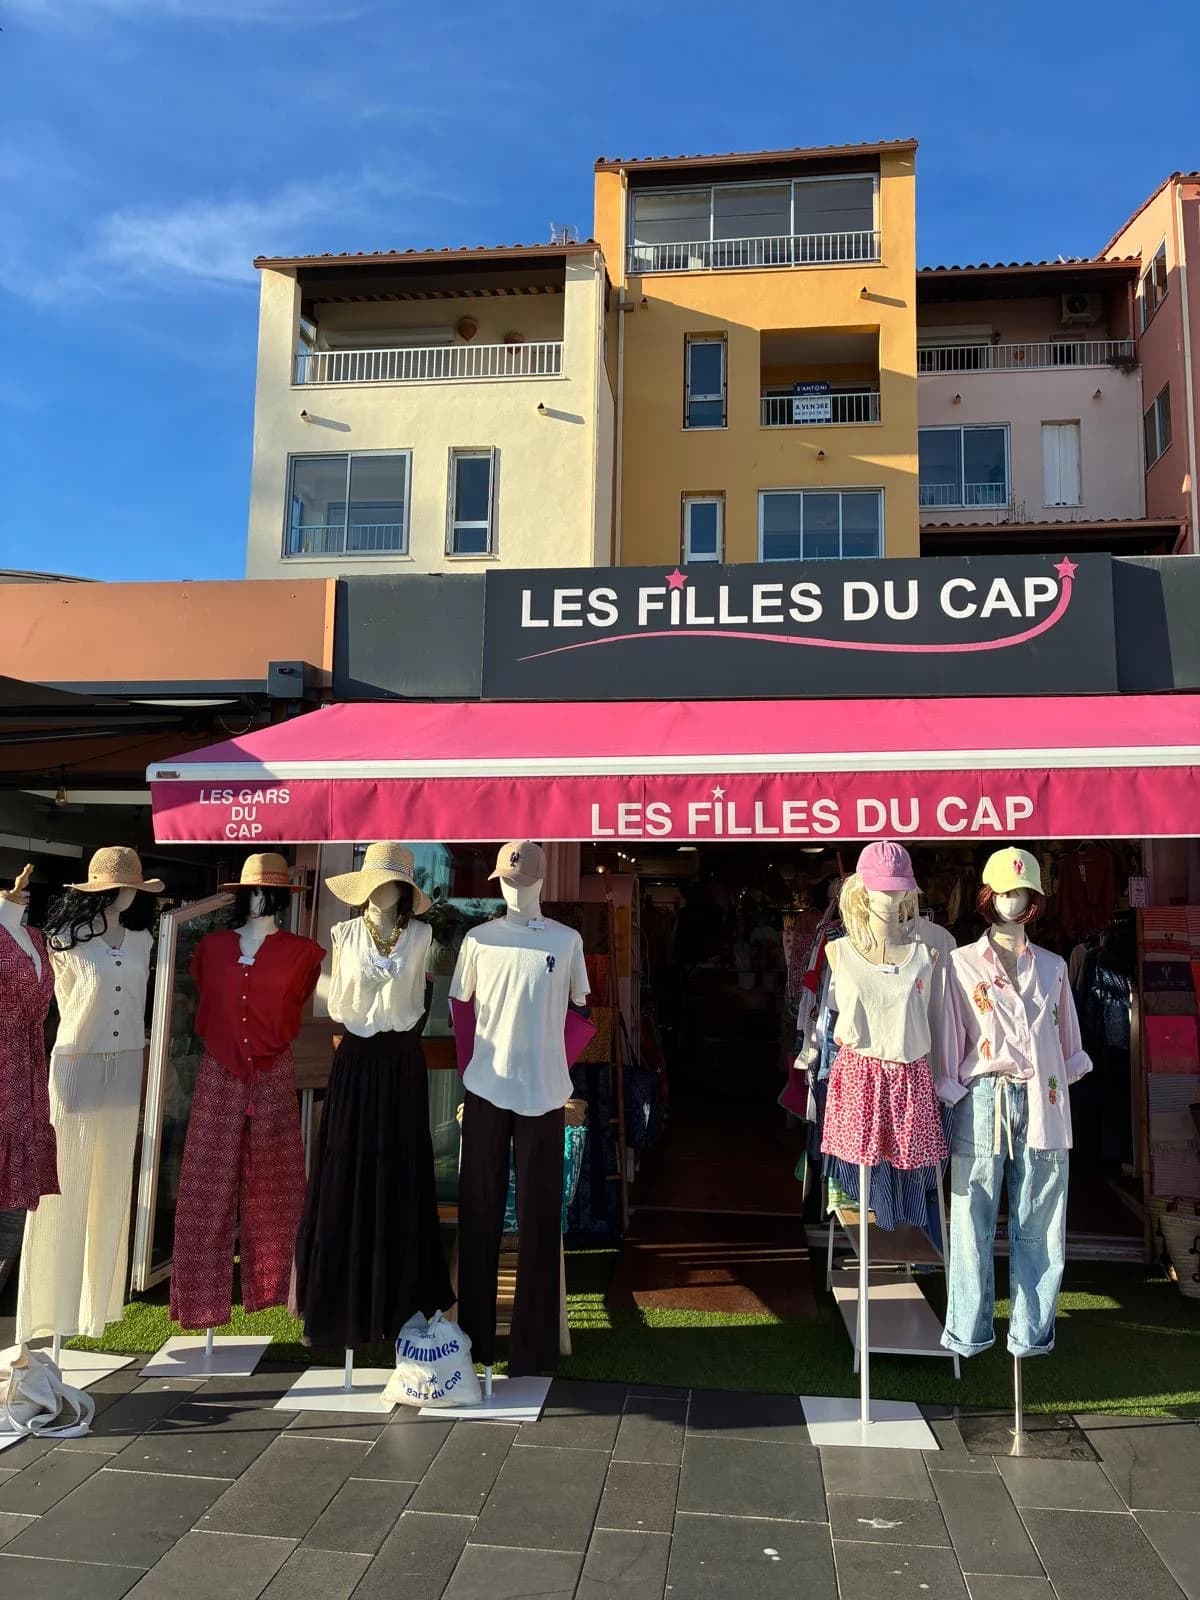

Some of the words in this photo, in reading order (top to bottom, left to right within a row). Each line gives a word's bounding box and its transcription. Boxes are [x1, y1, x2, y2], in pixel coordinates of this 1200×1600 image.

[522, 587, 619, 628] LES
[843, 579, 919, 621] DU
[940, 576, 1059, 619] CAP
[199, 789, 234, 805] LES
[238, 789, 291, 805] GARS
[231, 806, 257, 821] DU
[592, 802, 673, 836] LES
[856, 797, 920, 833] DU
[936, 795, 1034, 833] CAP
[225, 823, 263, 838] CAP
[396, 1337, 460, 1362] Hommes
[405, 1387, 429, 1400] gars
[431, 1388, 445, 1399] du
[444, 1370, 463, 1391] Cap
